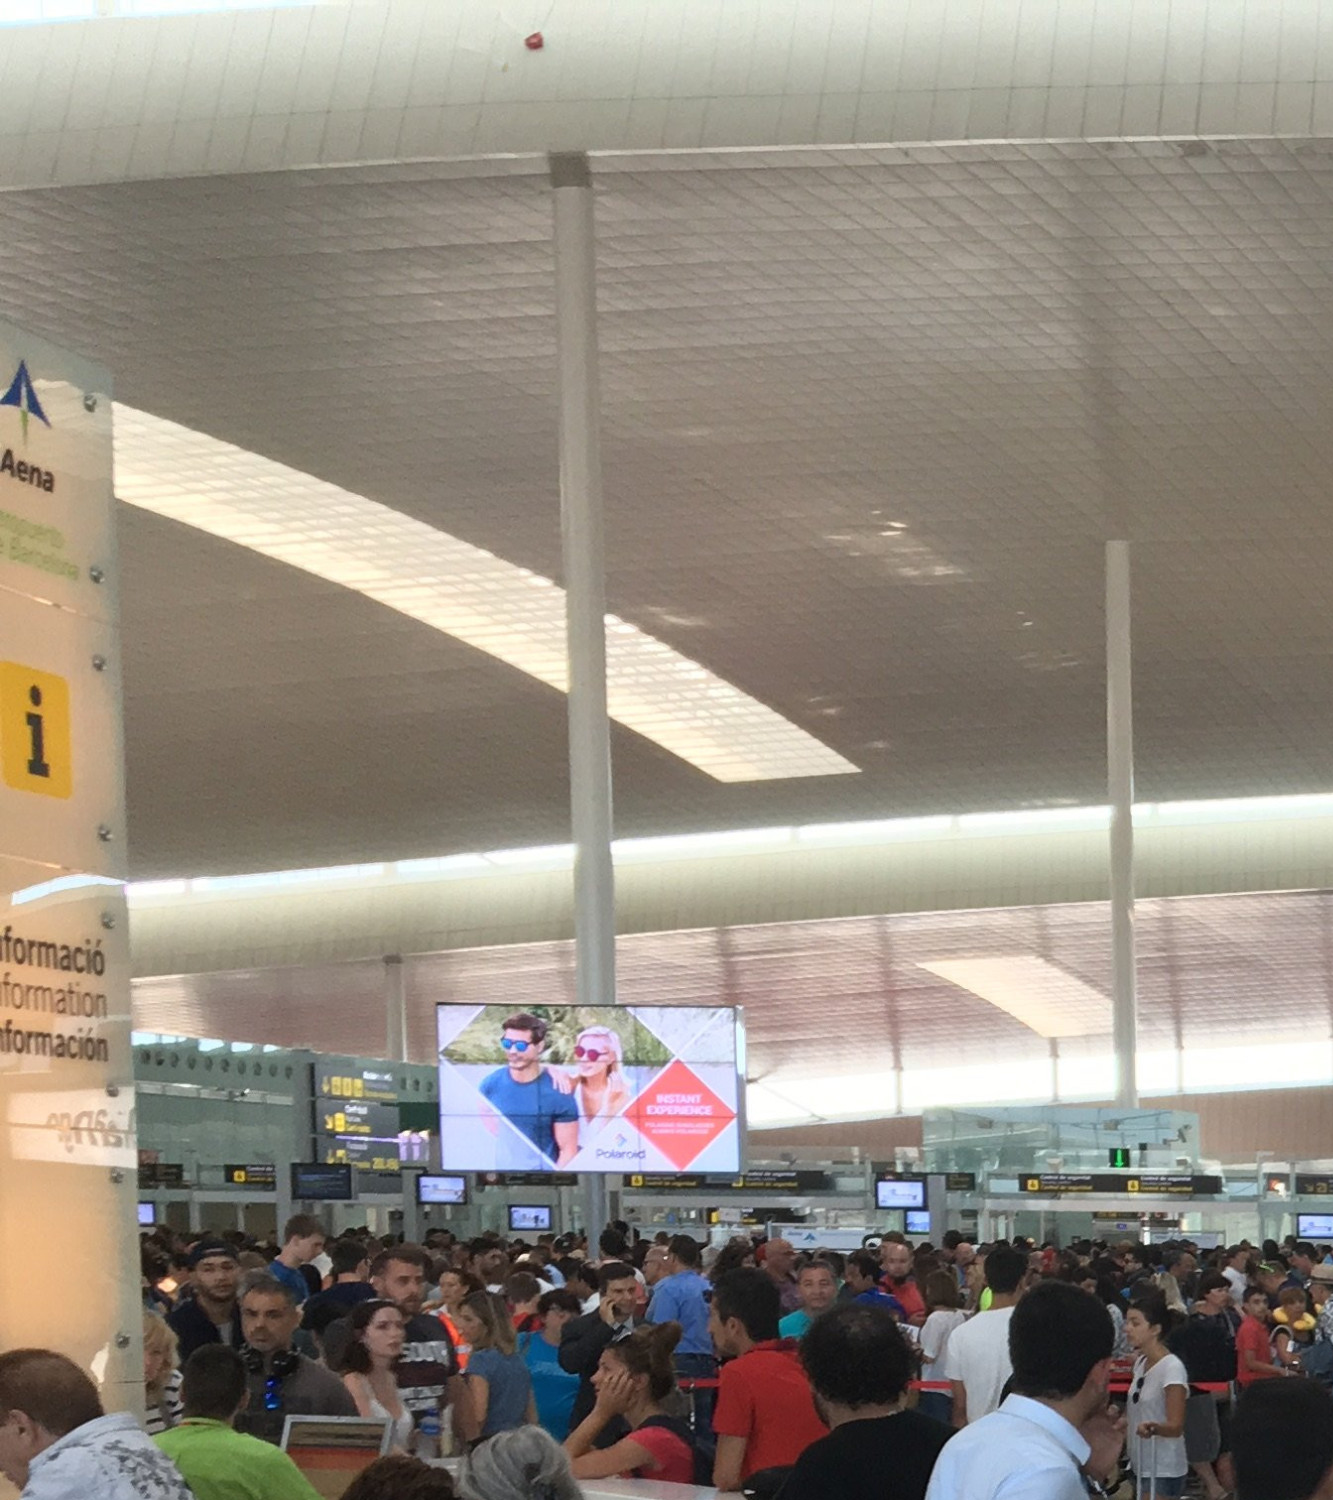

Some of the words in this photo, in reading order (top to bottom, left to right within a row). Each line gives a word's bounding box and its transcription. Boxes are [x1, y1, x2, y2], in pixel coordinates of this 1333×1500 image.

[1, 449, 54, 493] Aena
[656, 1094, 701, 1103] INSTANT
[646, 1105, 713, 1115] EXPERIENCE
[596, 1148, 646, 1159] Polaroid
